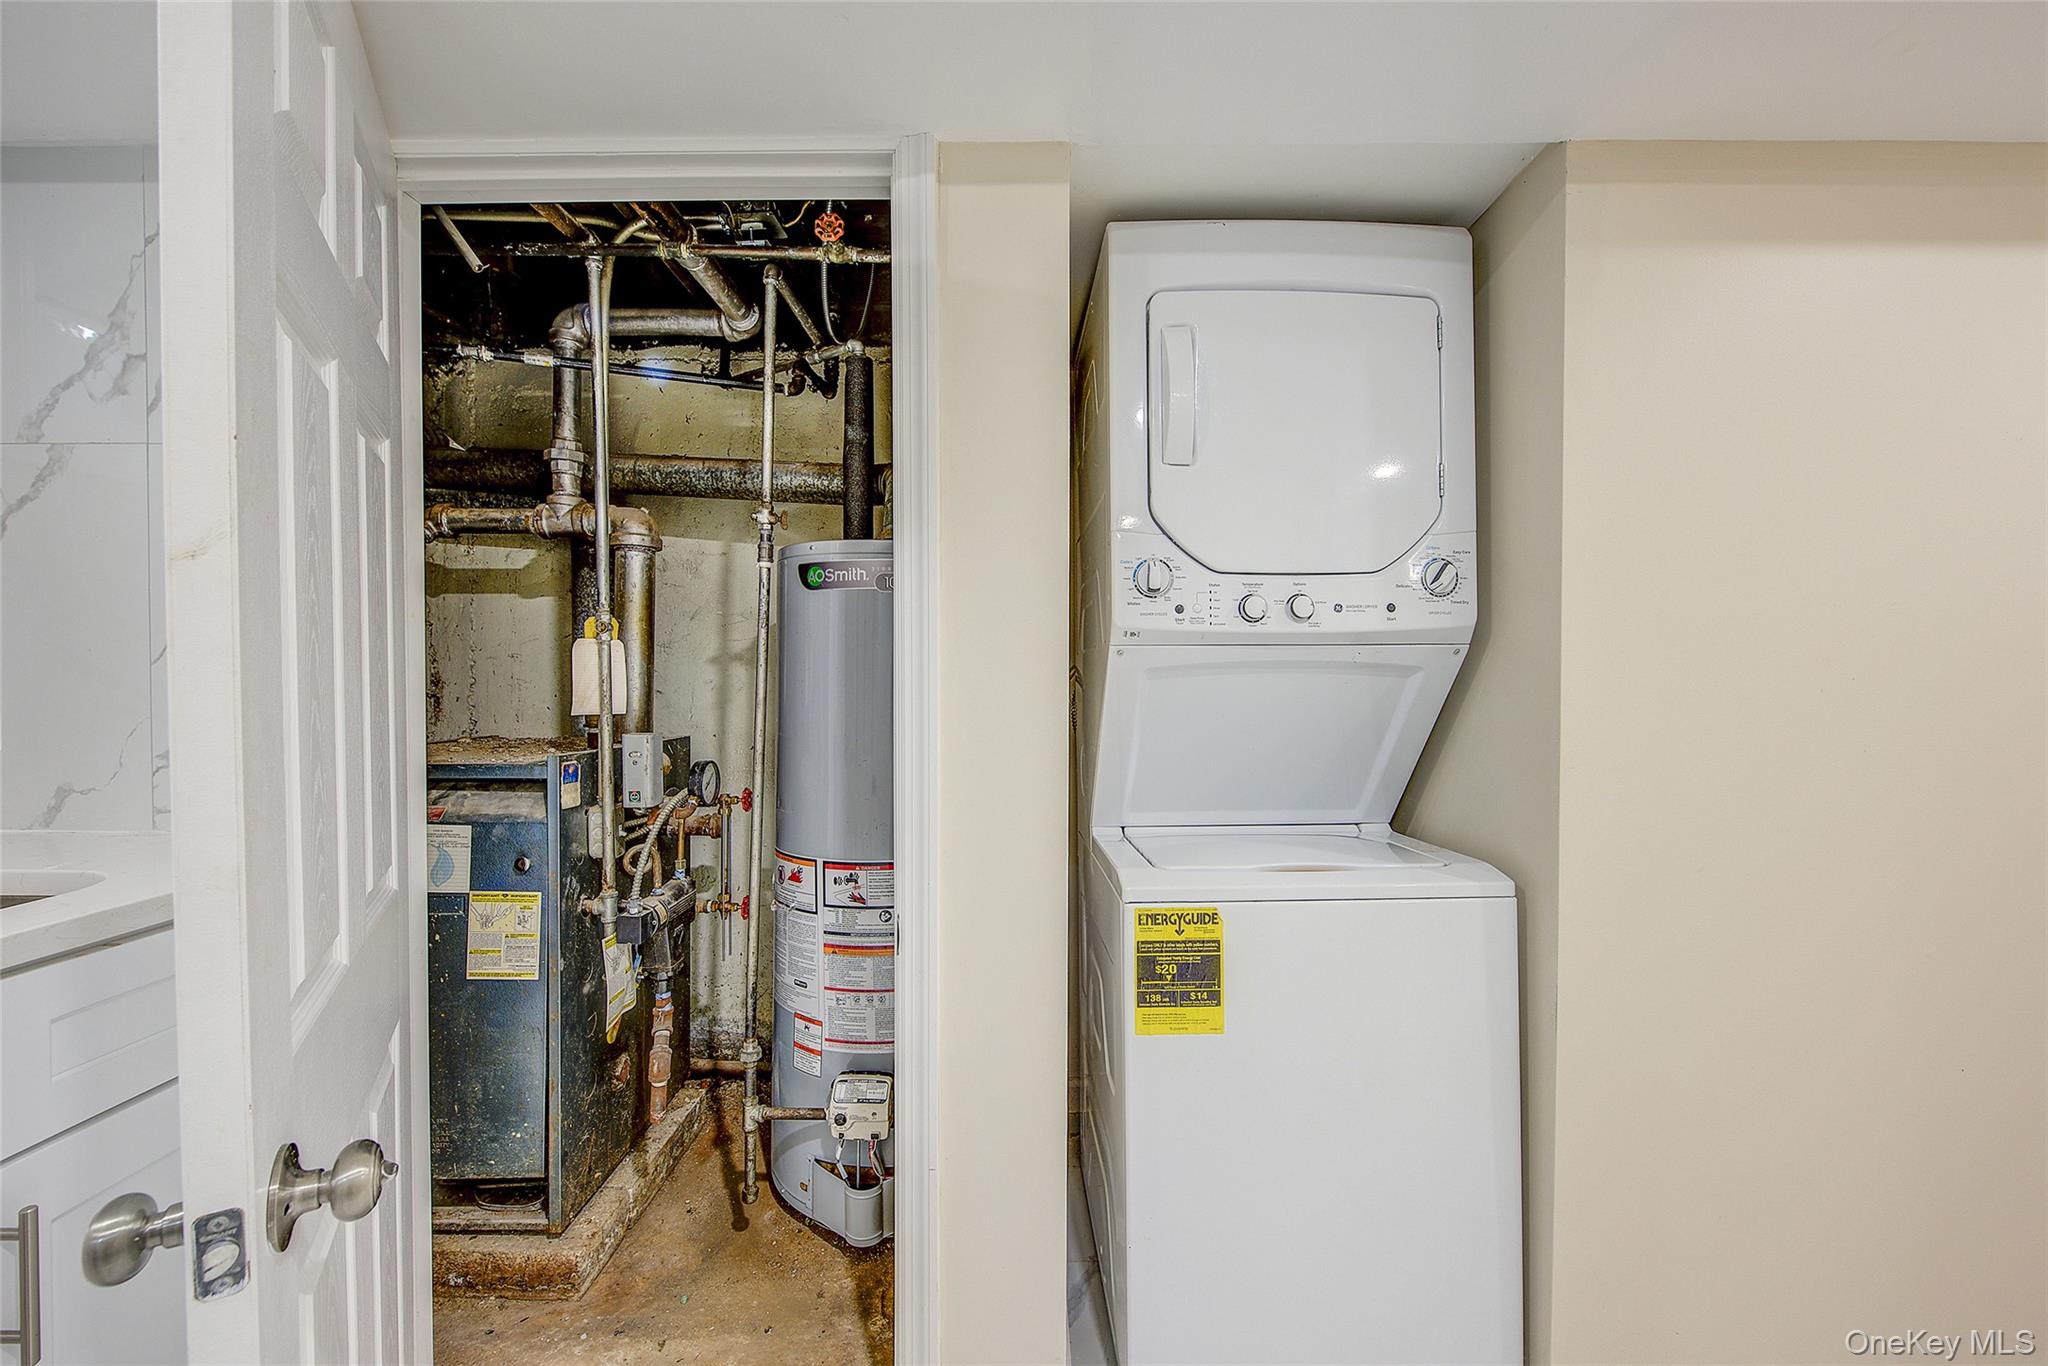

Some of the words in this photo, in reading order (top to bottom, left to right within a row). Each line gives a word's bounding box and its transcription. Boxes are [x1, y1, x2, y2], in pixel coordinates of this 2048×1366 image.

[1138, 912, 1219, 926] ENERGYGUIDE
[1155, 964, 1177, 974] $20
[1145, 994, 1161, 1002] 138
[1190, 992, 1208, 1000] $14
